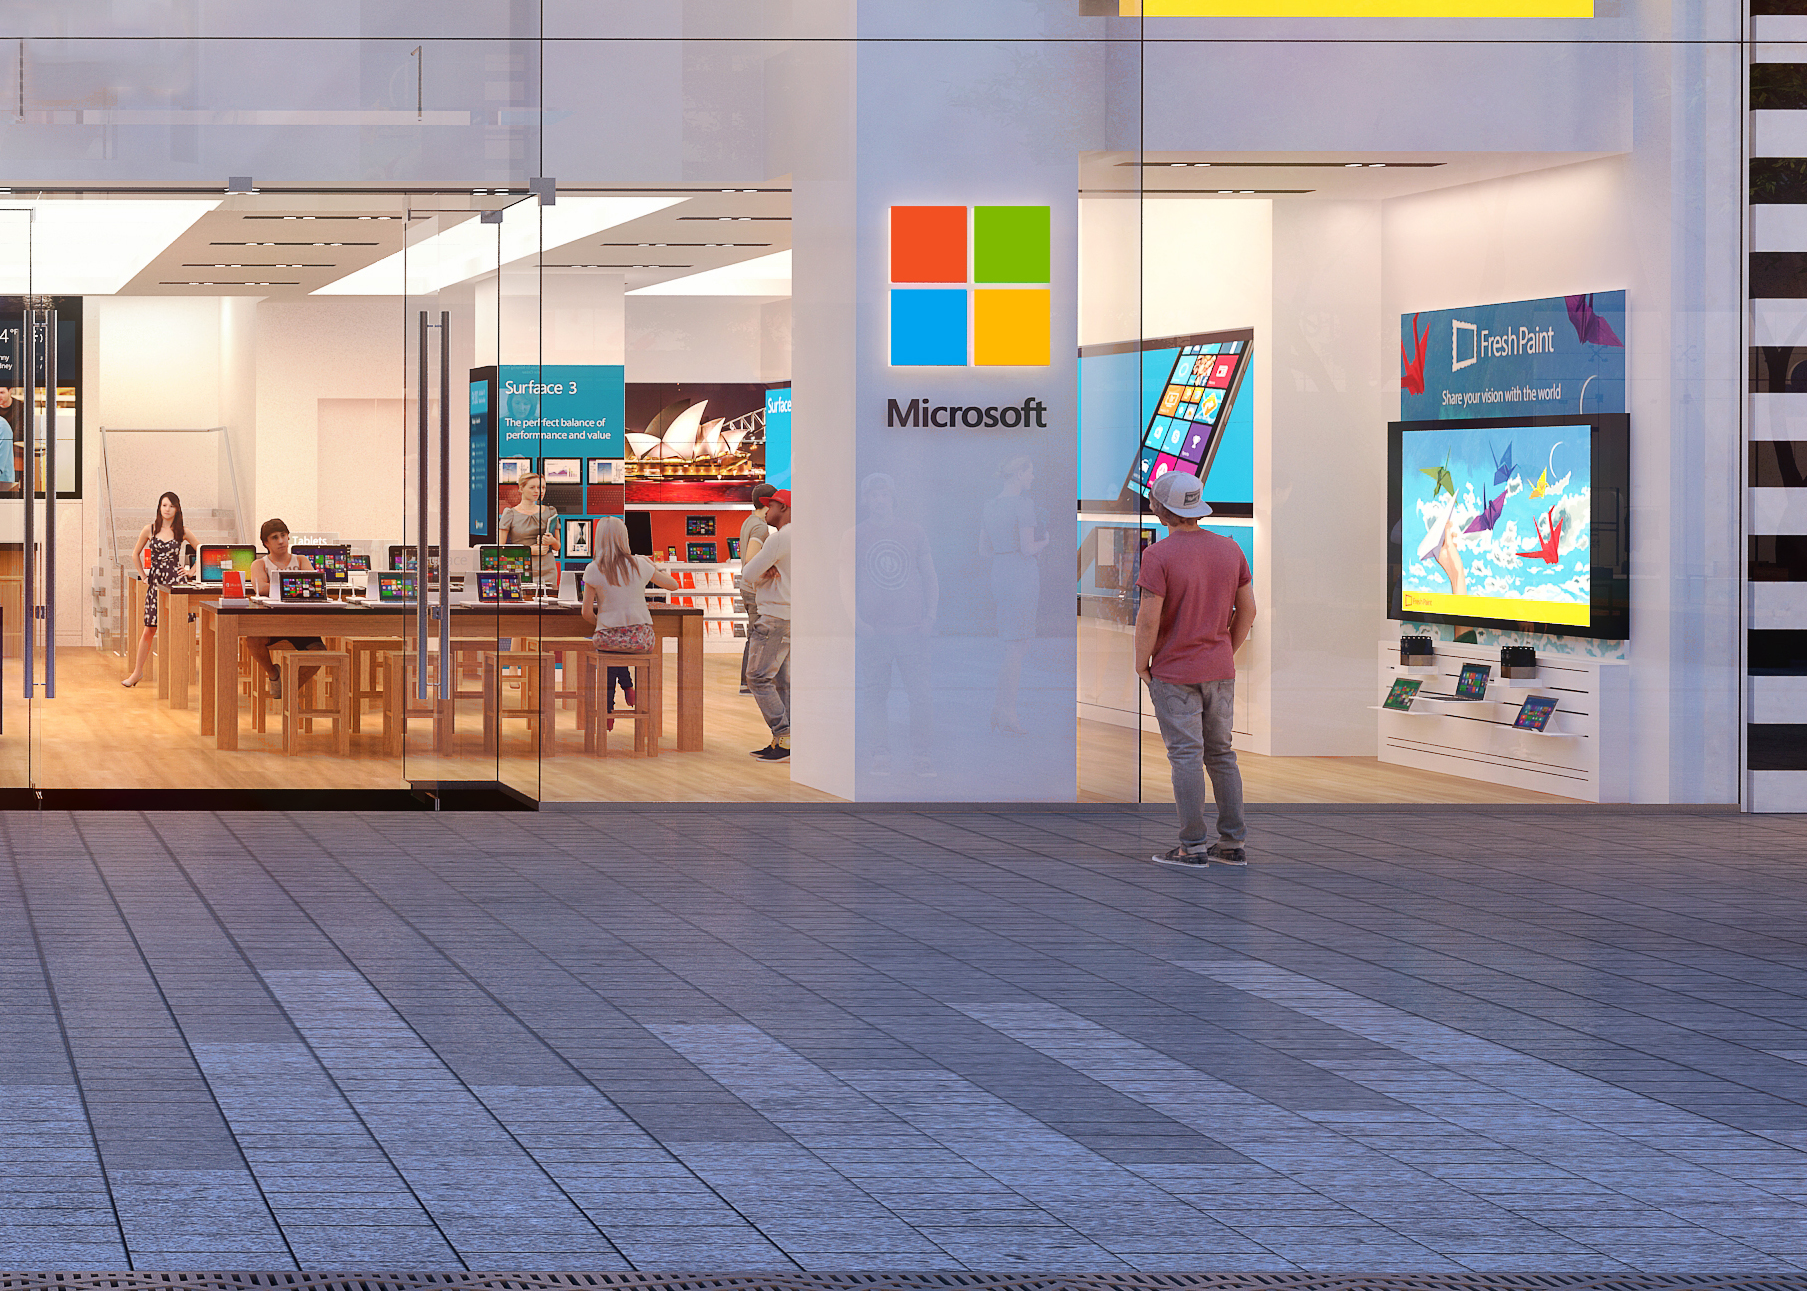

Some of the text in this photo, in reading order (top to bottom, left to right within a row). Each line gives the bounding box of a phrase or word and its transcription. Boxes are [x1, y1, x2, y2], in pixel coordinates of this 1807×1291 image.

[1480, 325, 1555, 358] Fresh Paint
[568, 381, 578, 395] 3
[1442, 382, 1562, 409] Share your vision with the world
[767, 395, 792, 414] Surface
[887, 397, 1048, 428] Microsoft
[504, 417, 522, 428] The
[561, 417, 595, 428] balance
[596, 417, 607, 428] of
[568, 430, 586, 440] and
[586, 431, 612, 440] value
[292, 535, 328, 545] Tablets
